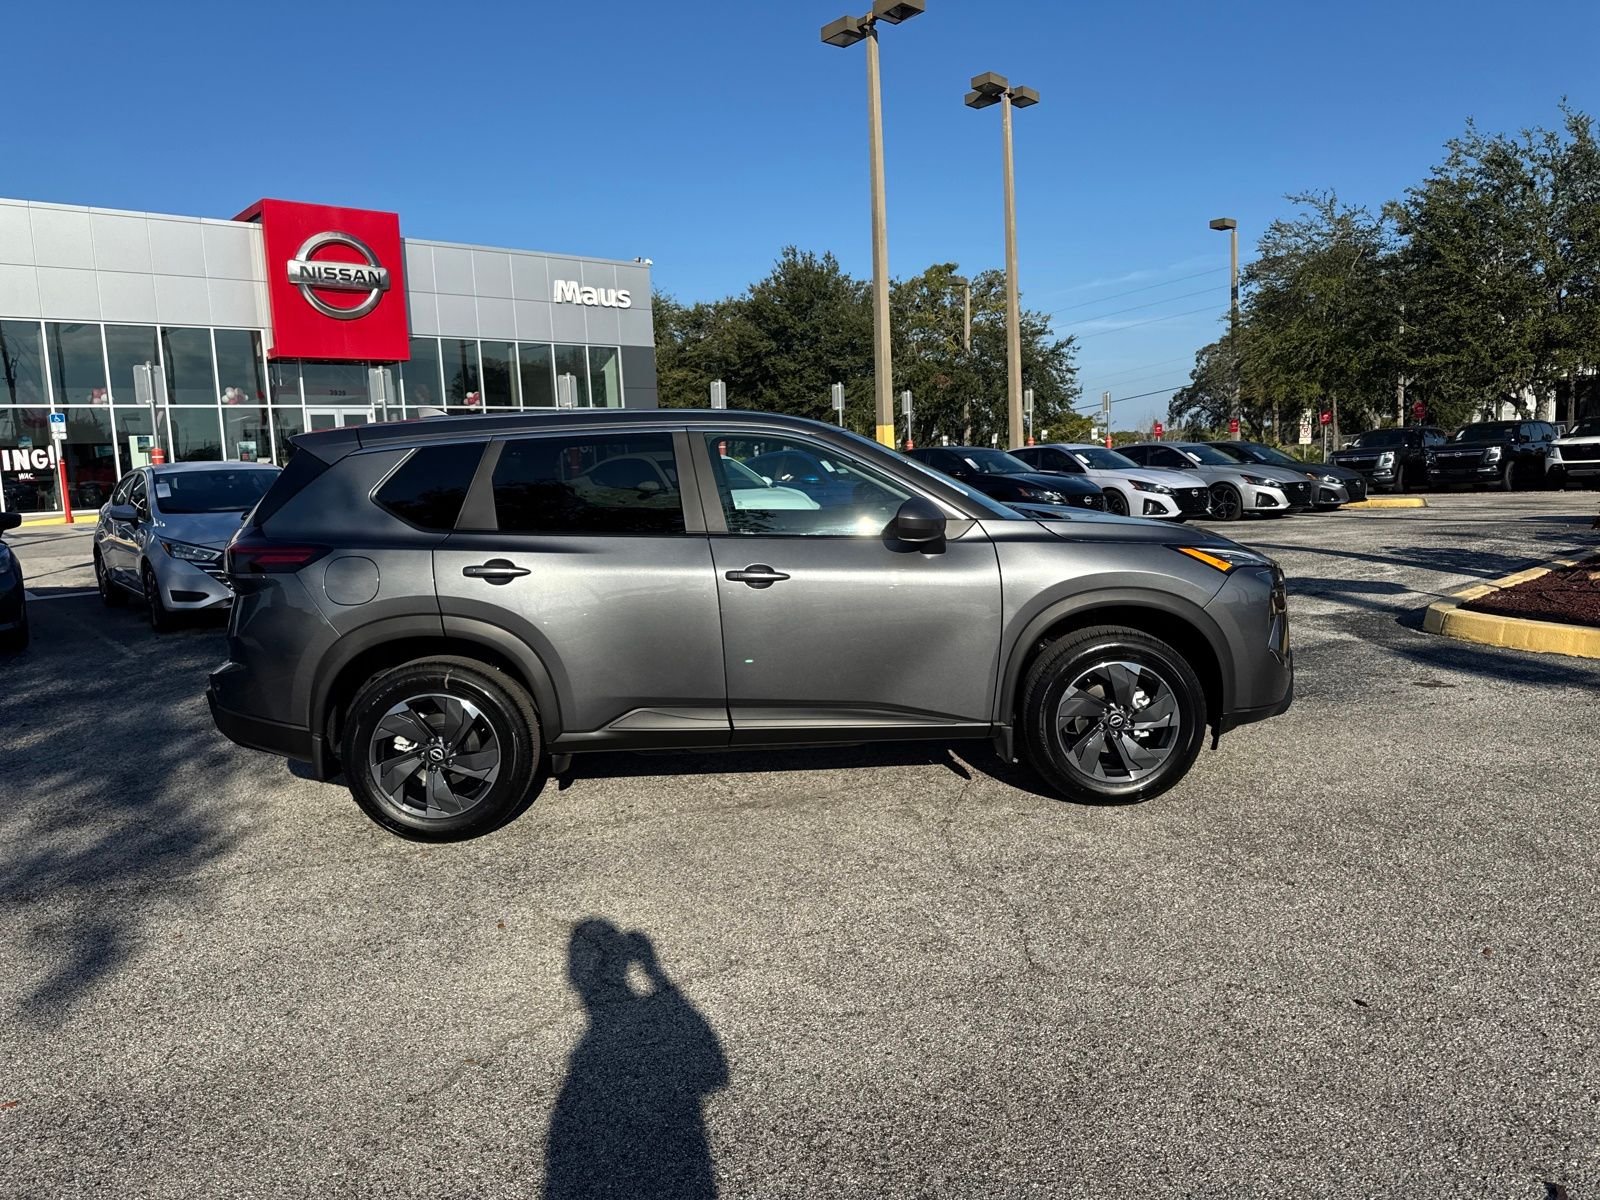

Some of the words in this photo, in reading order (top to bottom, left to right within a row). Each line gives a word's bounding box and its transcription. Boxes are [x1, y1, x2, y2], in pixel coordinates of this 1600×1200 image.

[299, 265, 381, 284] NISSAN
[554, 279, 632, 309] Maus
[1, 445, 55, 471] ING!
